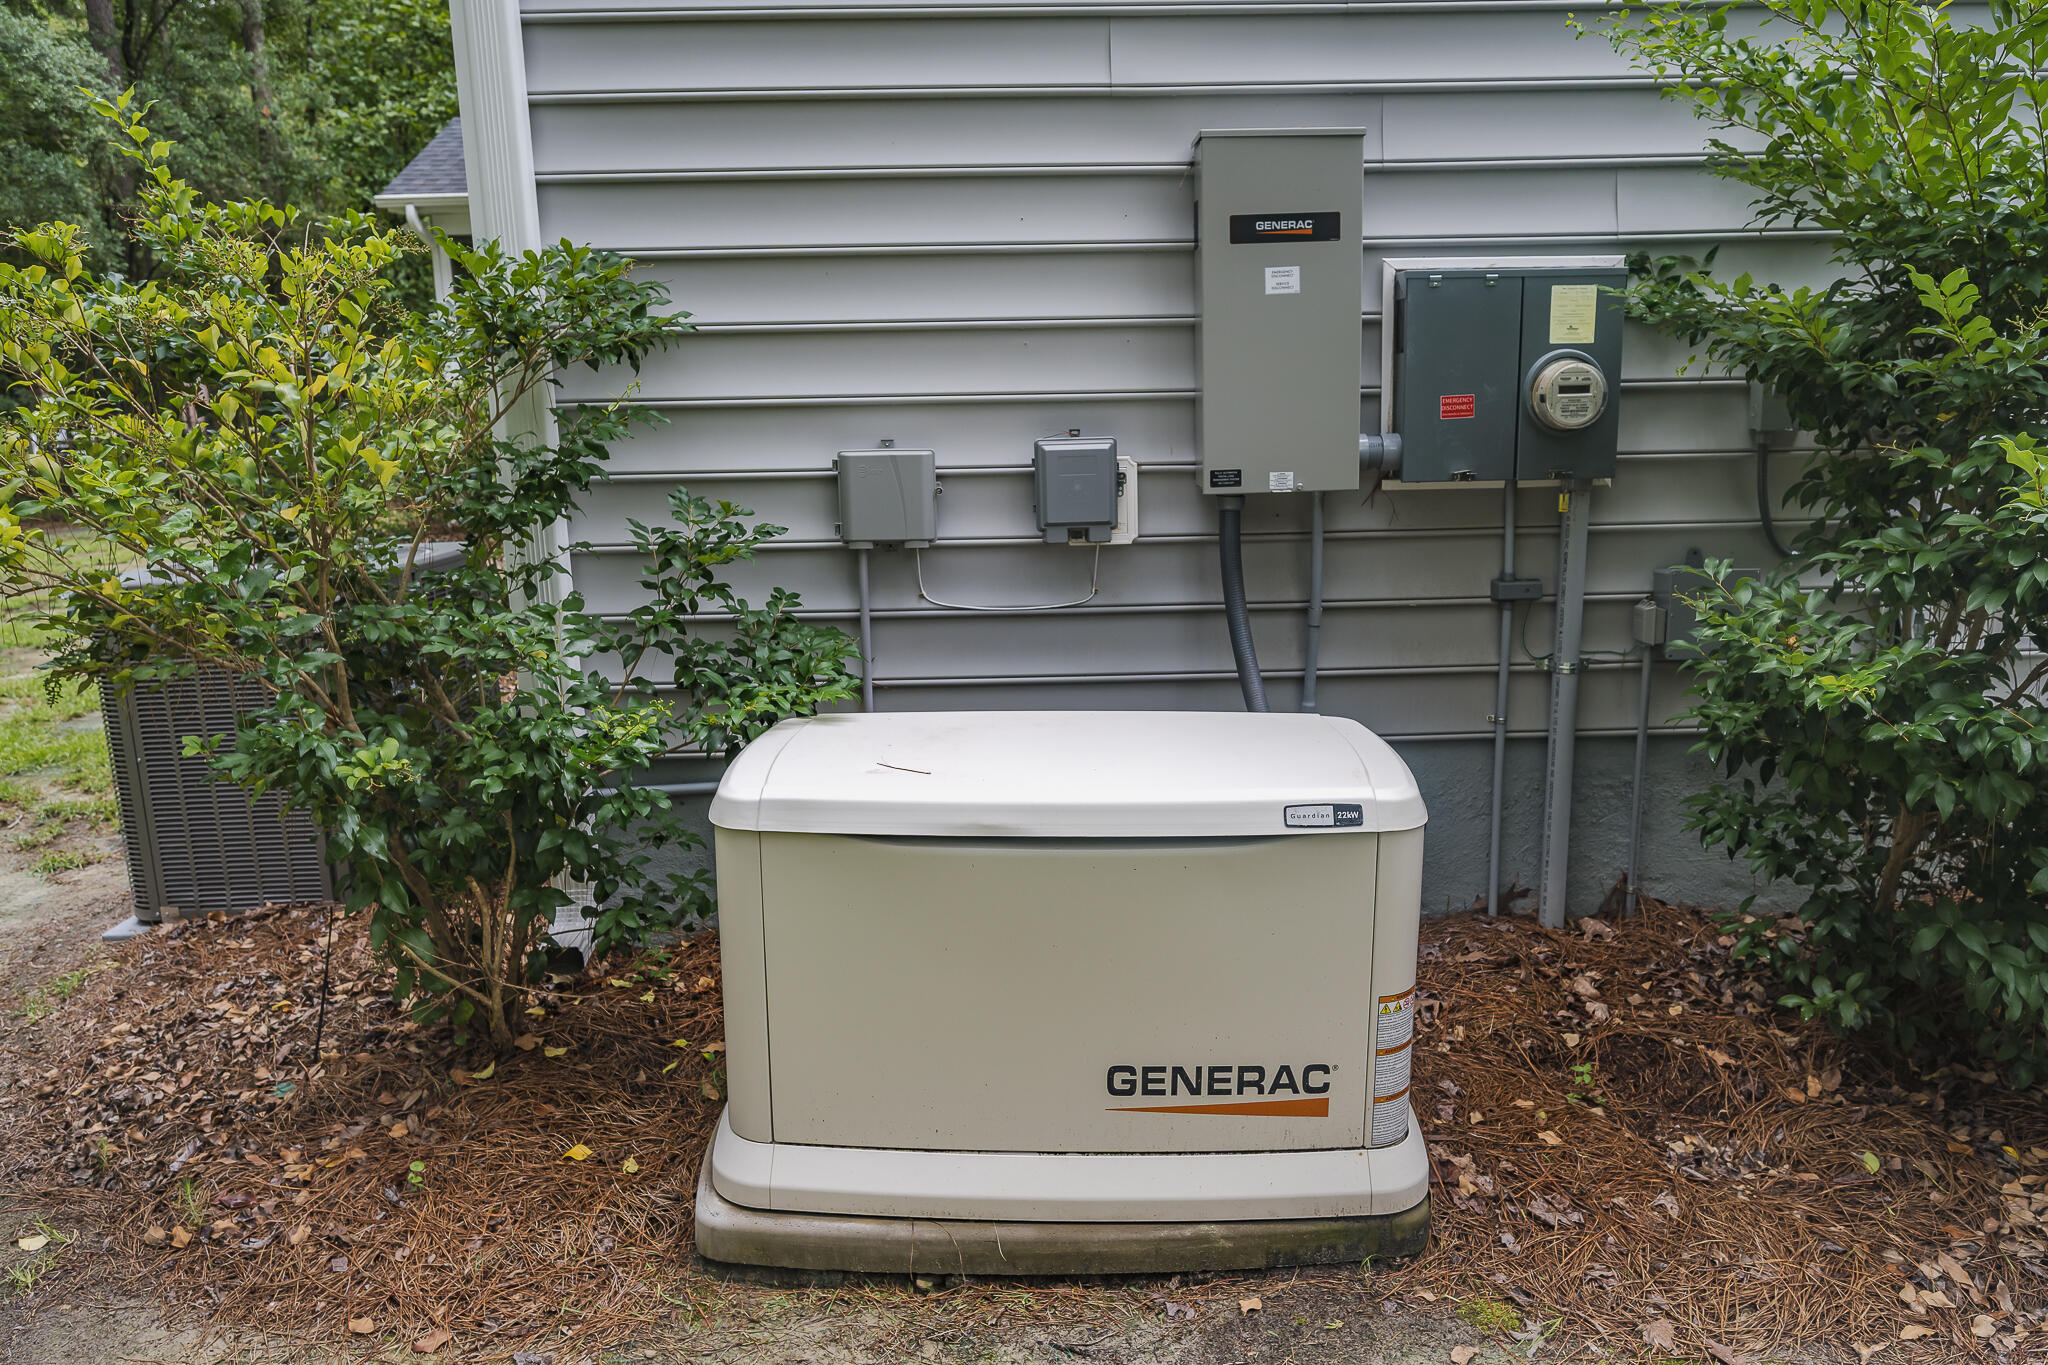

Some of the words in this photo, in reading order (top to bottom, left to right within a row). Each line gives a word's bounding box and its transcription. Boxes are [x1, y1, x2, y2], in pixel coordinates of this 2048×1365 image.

[1255, 220, 1313, 230] GENERAC
[1290, 812, 1330, 820] Guardian
[1336, 811, 1359, 819] 22kW
[1106, 1063, 1331, 1097] GENERAC
